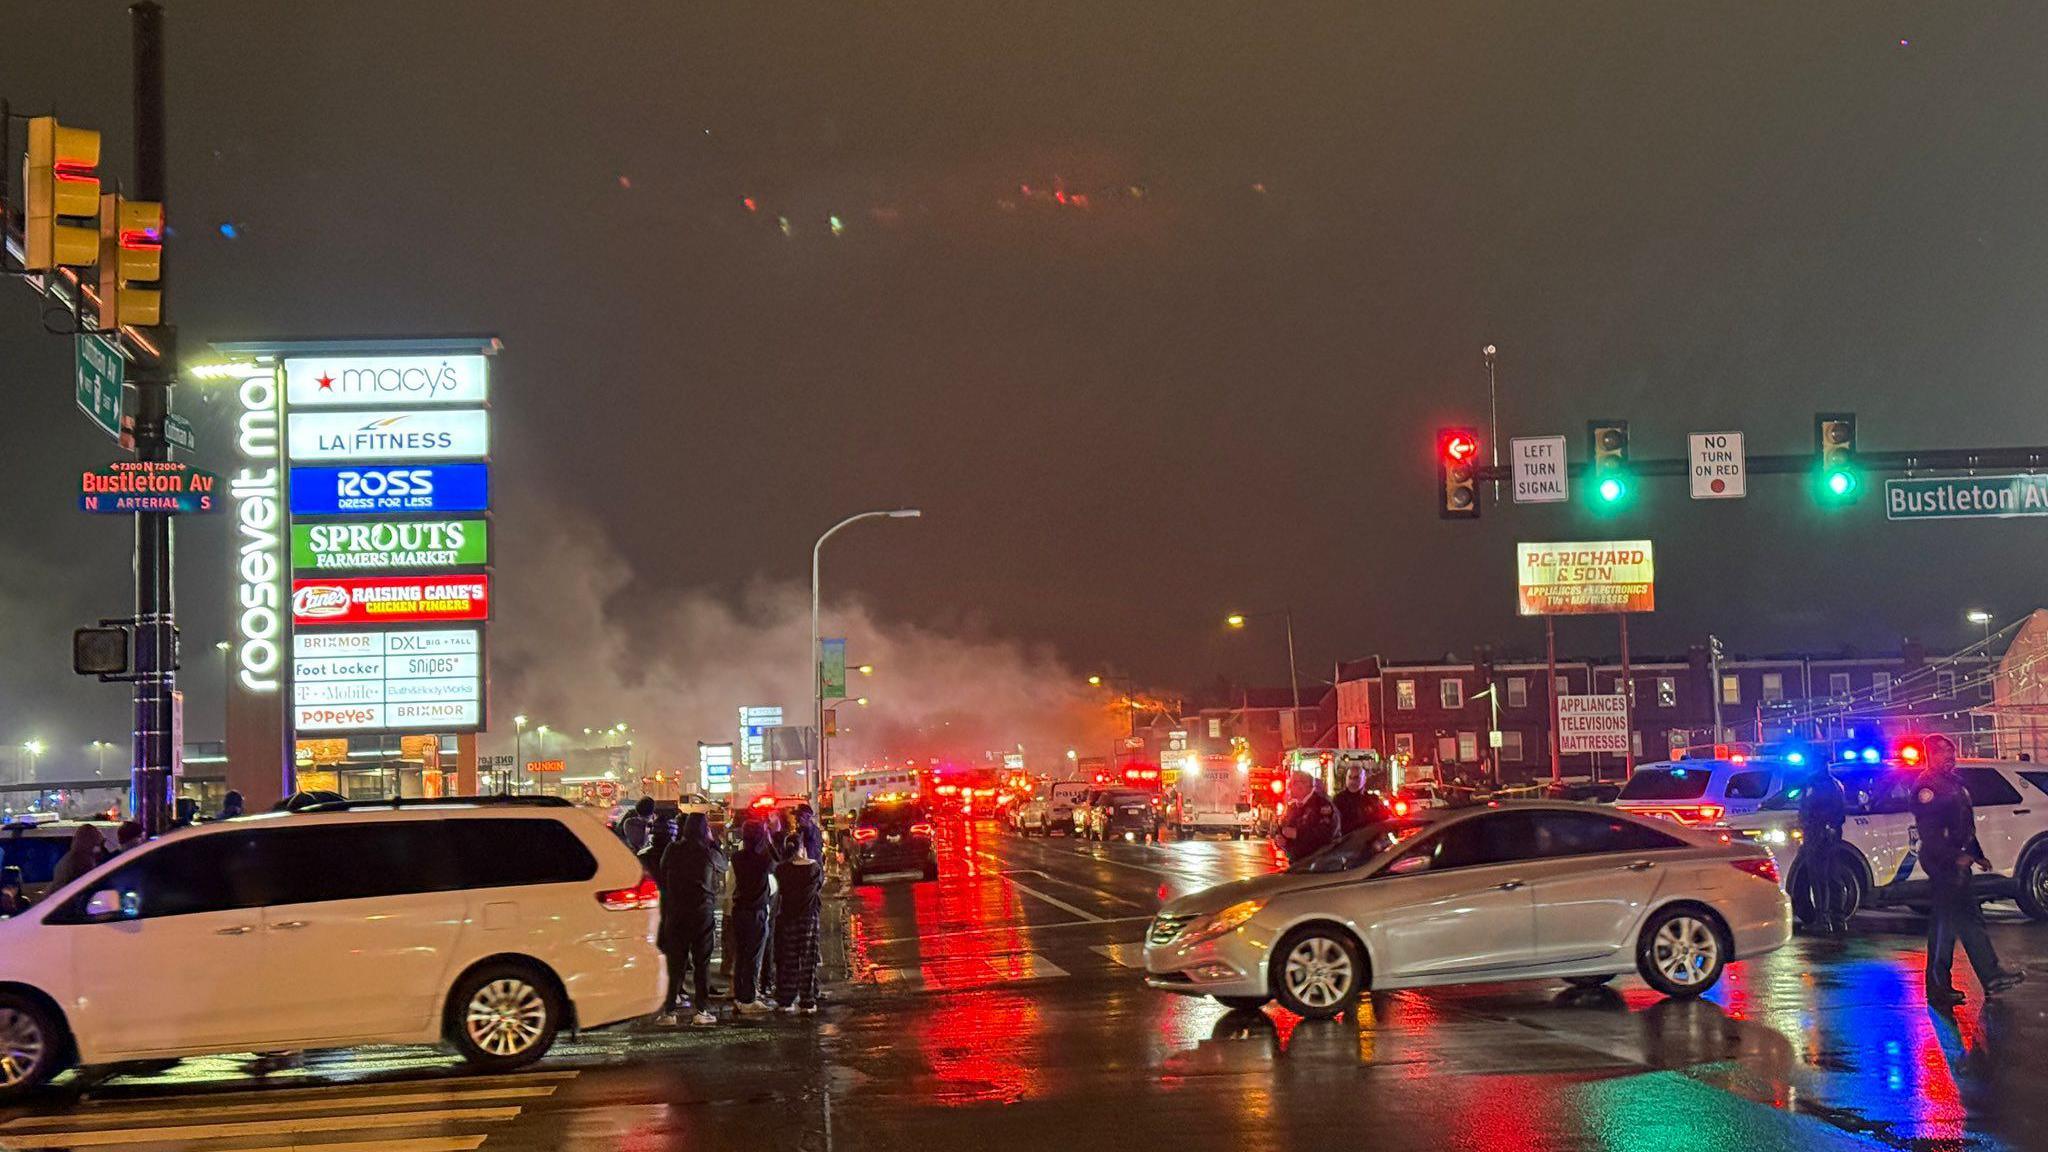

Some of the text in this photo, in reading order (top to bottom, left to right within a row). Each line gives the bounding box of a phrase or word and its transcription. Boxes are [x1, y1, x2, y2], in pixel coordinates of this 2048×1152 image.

[343, 360, 457, 398] macy's
[319, 432, 452, 450] LA FITNESS
[1705, 436, 1727, 448] NO
[1524, 445, 1552, 458] LEFT
[1701, 452, 1732, 463] TURN
[144, 461, 153, 471] N
[155, 463, 177, 471] 7200
[1524, 463, 1555, 475] TURN
[1695, 464, 1739, 476] ON RED
[82, 472, 213, 493] Bustleton Av
[337, 470, 433, 497] ROSS
[1519, 481, 1562, 494] SIGNAL
[85, 495, 211, 510] N ARTERIAL S
[338, 497, 433, 508] DRESS FOR LESS
[1891, 485, 2014, 513] Bustleton
[309, 522, 466, 552] SPROUTS
[316, 550, 458, 568] FARMERS MARKET
[1558, 550, 1644, 566] RICHARD
[231, 468, 276, 692] roosevelt
[1557, 567, 1612, 581] & SON
[352, 584, 484, 602] RAISING CANE'S
[1527, 586, 1581, 596] APPLIANCES
[366, 599, 470, 613] CHICKEN FINGERS
[304, 637, 370, 648] BRIXMOR
[391, 636, 427, 650] DXL
[296, 662, 379, 676] Foot Locker
[398, 705, 464, 717] BRIXMOR
[1560, 697, 1625, 712] APPLIANCES
[1561, 716, 1627, 731] TELEVISIONS
[1561, 735, 1627, 750] MATTRESSES
